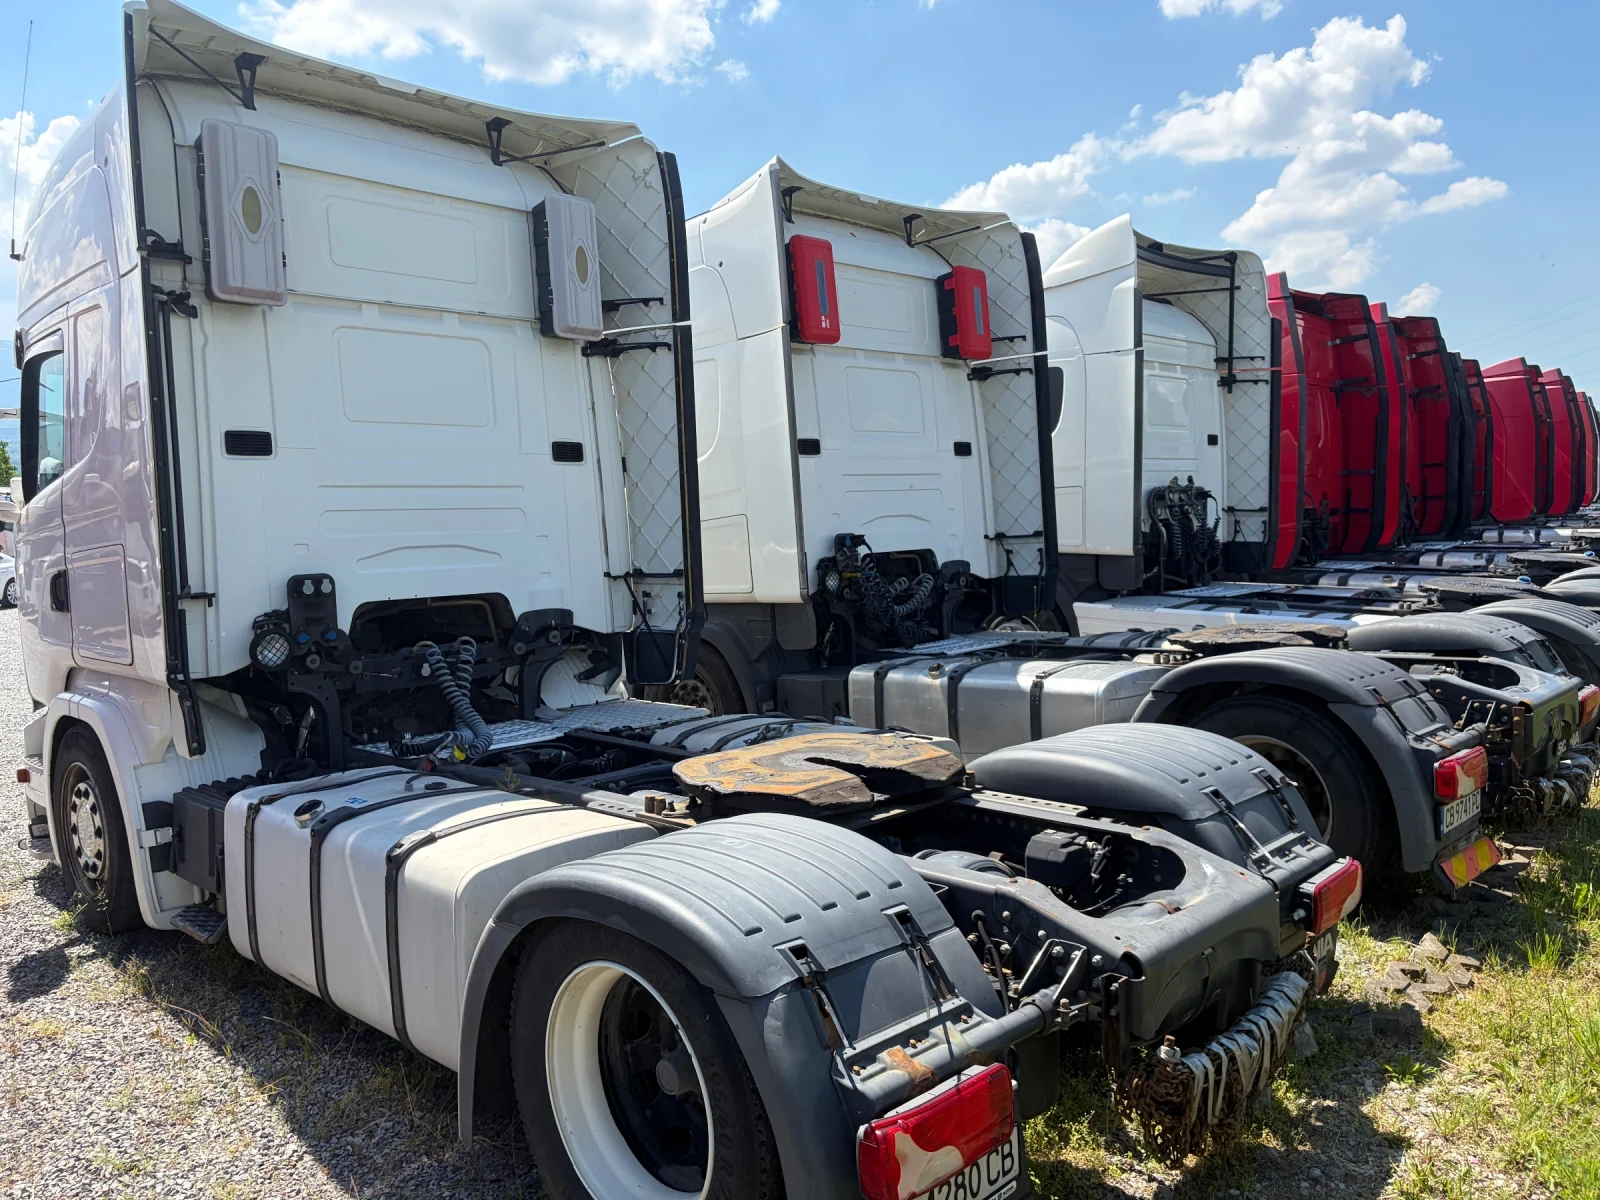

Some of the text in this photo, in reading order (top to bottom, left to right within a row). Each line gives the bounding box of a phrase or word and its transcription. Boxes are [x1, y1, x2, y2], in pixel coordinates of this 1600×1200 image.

[1445, 805, 1455, 829] CB
[1456, 795, 1471, 823] 9741
[927, 1138, 1014, 1200] 280 CB
